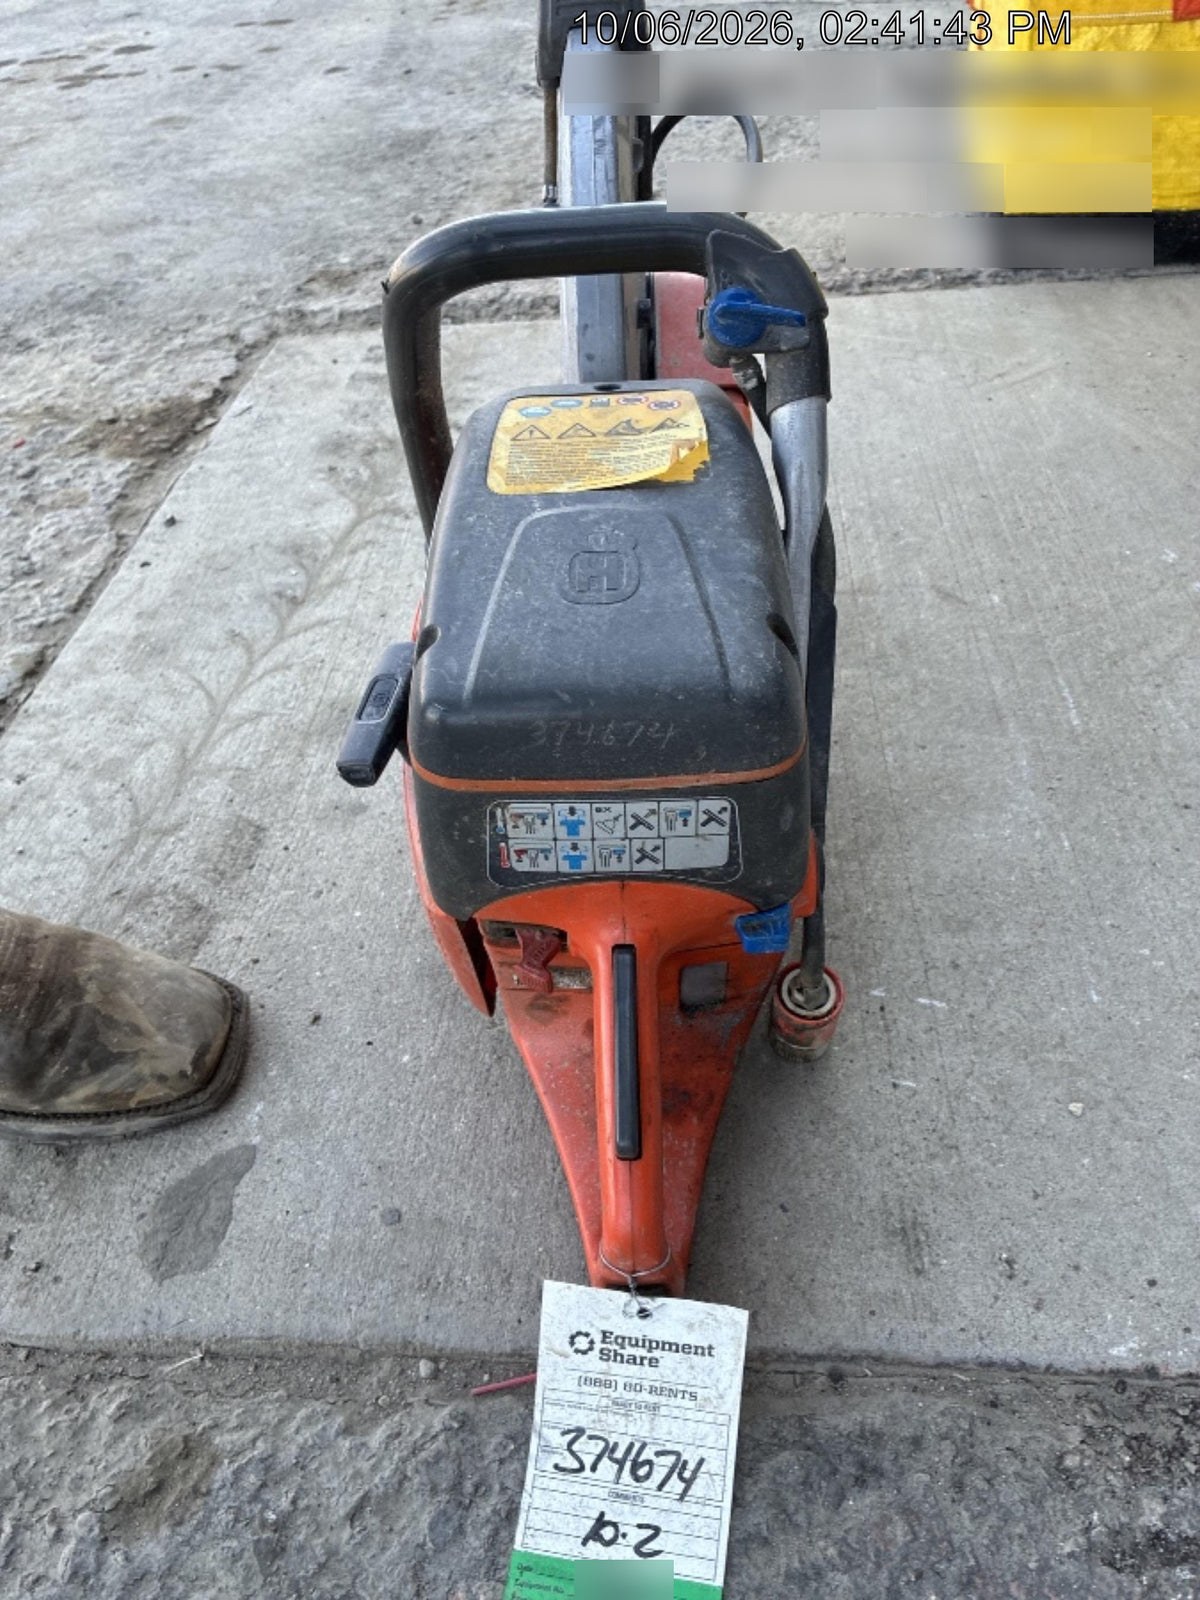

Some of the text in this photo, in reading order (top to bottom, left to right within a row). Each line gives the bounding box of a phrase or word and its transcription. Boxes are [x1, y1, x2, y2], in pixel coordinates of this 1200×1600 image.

[598, 1347, 660, 1368] Share
[599, 1329, 715, 1358] Equipment
[577, 1375, 699, 1402] (888) 80-RENTS
[552, 1425, 706, 1503] 374674
